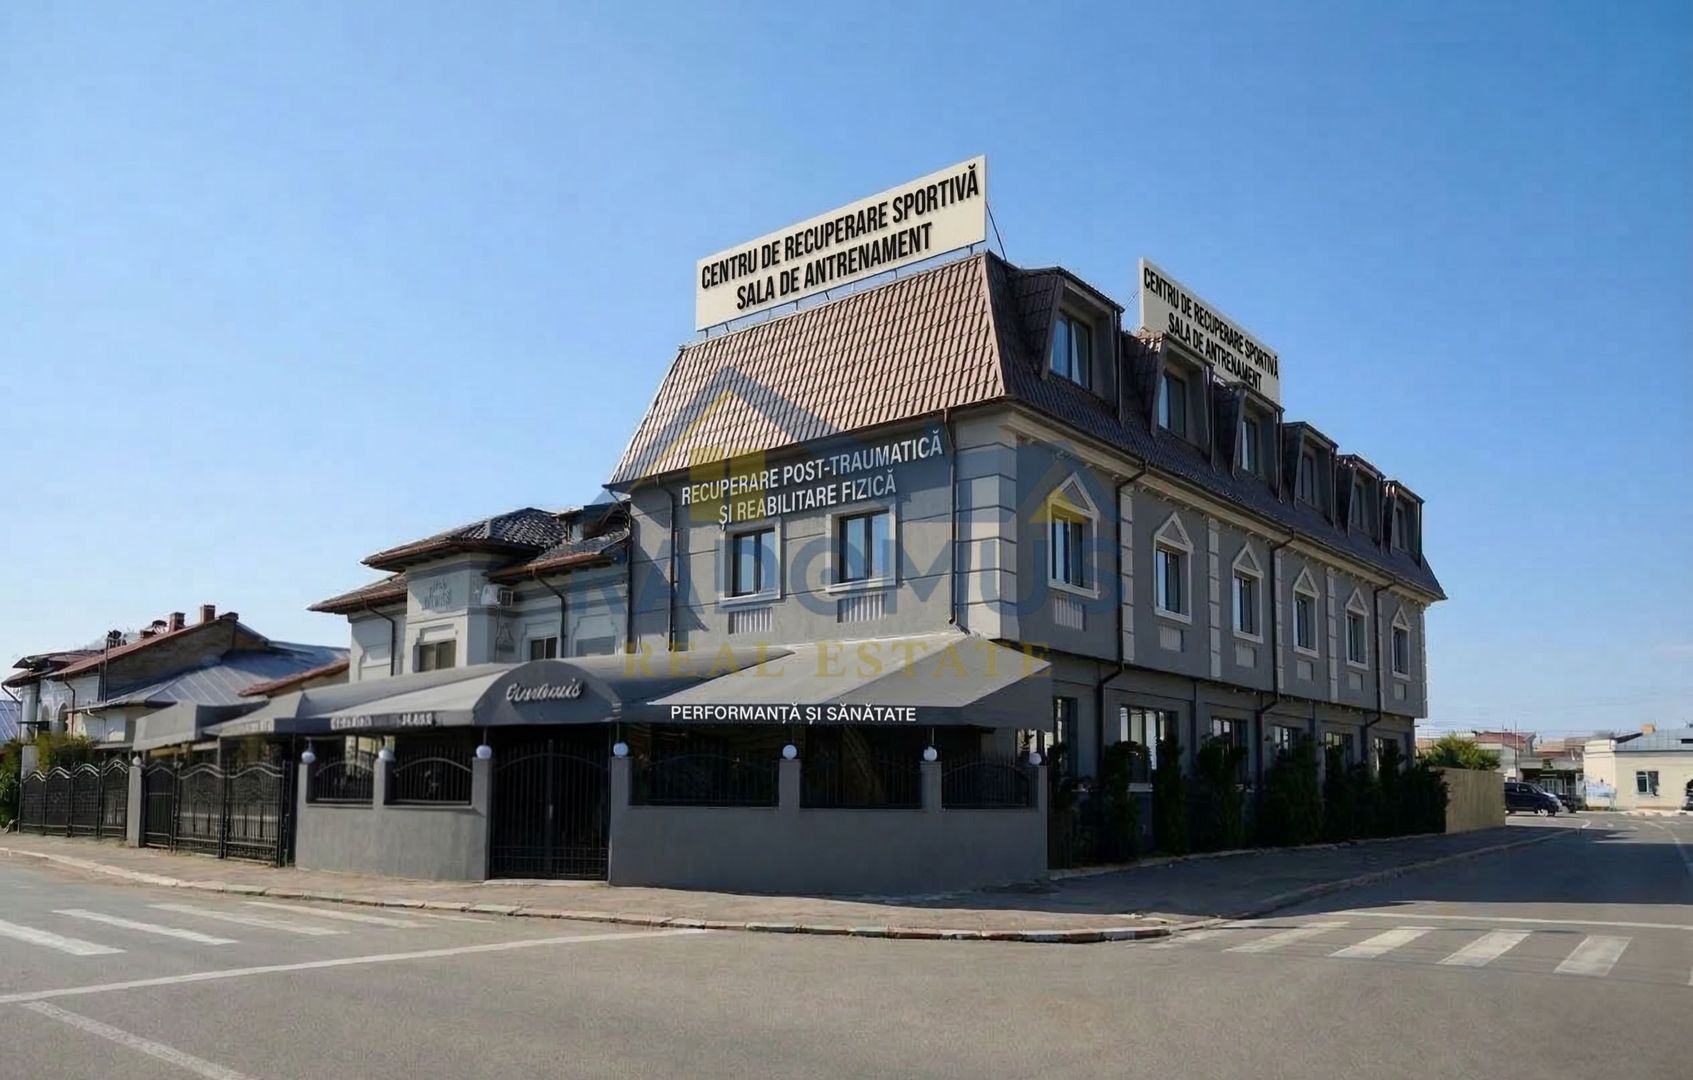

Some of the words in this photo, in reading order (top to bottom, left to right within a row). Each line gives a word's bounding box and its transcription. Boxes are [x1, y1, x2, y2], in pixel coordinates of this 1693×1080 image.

[702, 247, 758, 289] CENTRU
[762, 239, 782, 270] DE
[785, 201, 889, 262] RECUPERARE
[892, 163, 980, 223] SPORTIVĂ
[737, 282, 776, 311] SALA
[780, 267, 800, 297] DE
[804, 222, 933, 289] ANTRENAMENT
[1144, 267, 1180, 310] CENTRU
[1181, 293, 1193, 319] DE
[1194, 302, 1244, 355] RECUPERARE
[1168, 312, 1192, 345] SALA
[1193, 328, 1204, 354] DE
[1205, 338, 1263, 391] ANTRENAMENT
[682, 468, 779, 506] RECUPERARE
[783, 429, 943, 486] POST-TRAUMATICĂ
[737, 484, 837, 521] REABILITARE
[842, 468, 896, 502] FIZICĂ
[671, 703, 801, 724] PERFORMANȚĂ
[806, 707, 822, 725] ȘI
[827, 703, 917, 722] SĂNĂTATE
